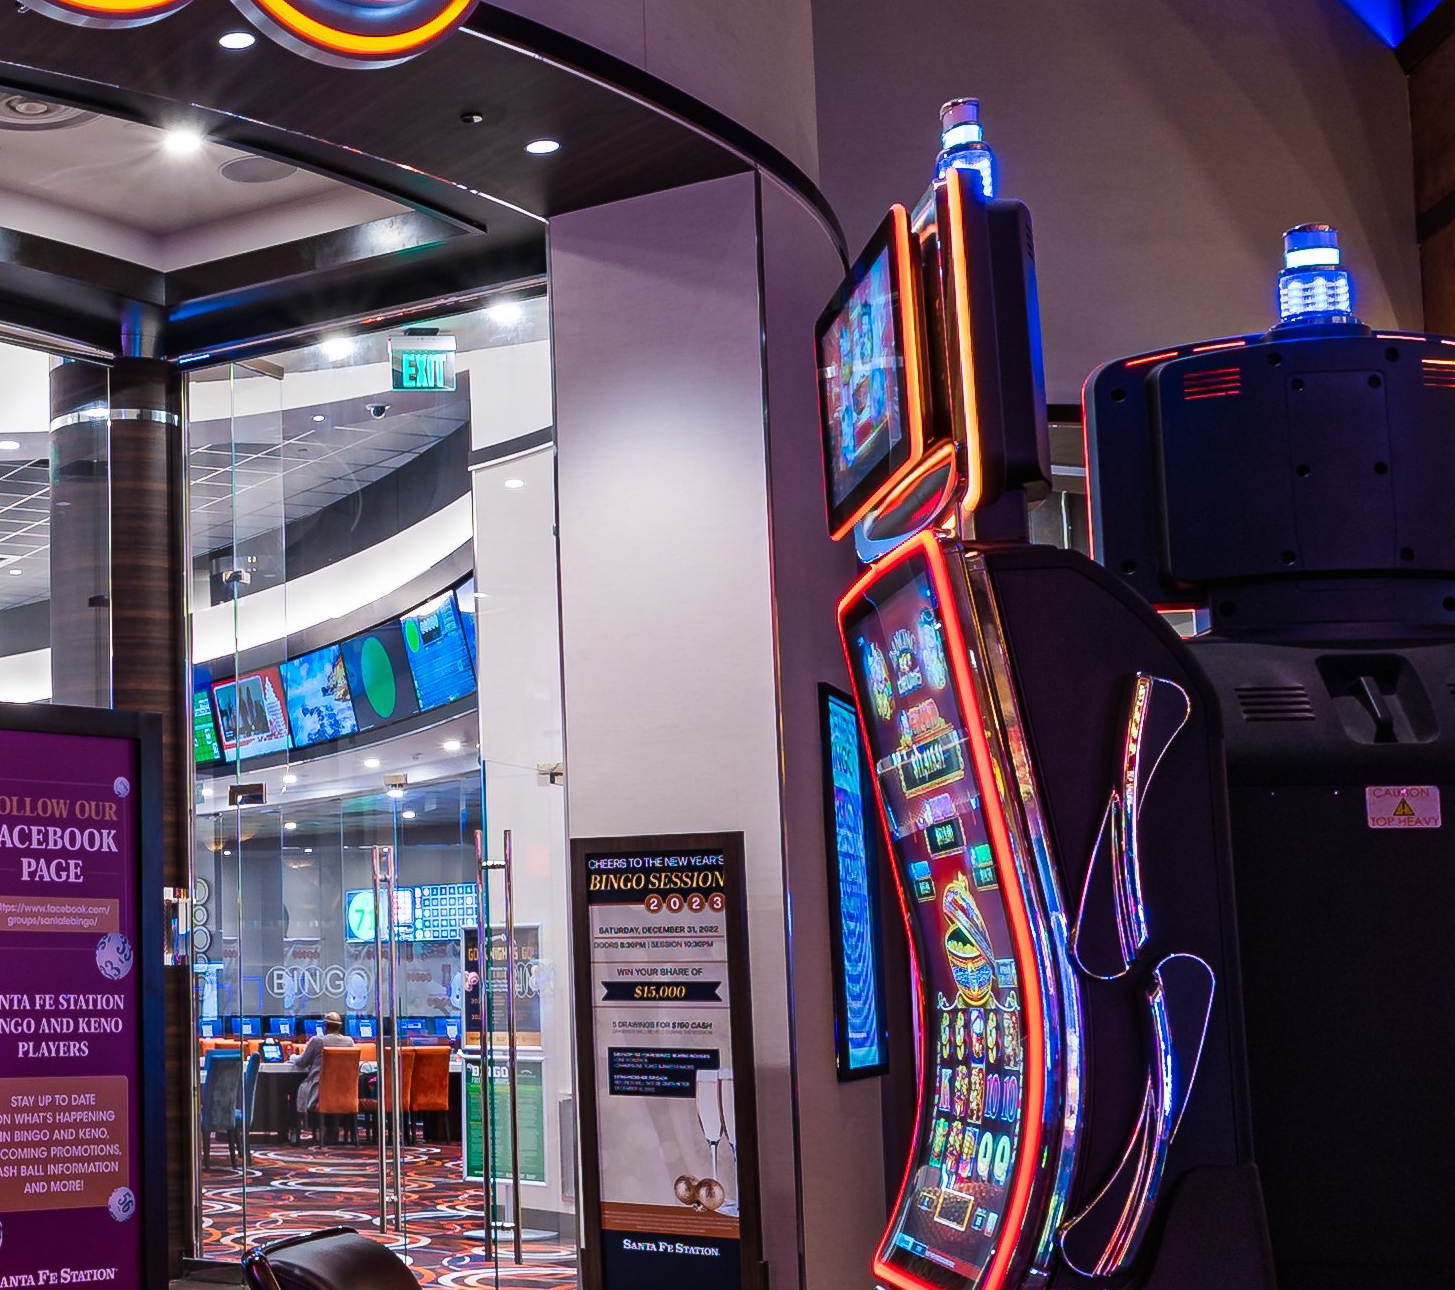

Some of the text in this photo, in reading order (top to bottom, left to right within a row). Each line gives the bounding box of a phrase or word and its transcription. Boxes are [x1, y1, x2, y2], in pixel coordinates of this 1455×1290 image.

[402, 354, 446, 388] EXIT
[75, 800, 118, 821] OUR
[1370, 817, 1439, 826] TOP HEAVY
[20, 858, 84, 882] PAGE
[588, 854, 724, 870] CHEERS TO THE NEW YEAR'S
[590, 871, 725, 891] BINGO SESSION
[7, 914, 99, 928] groups/santafebingo/
[617, 968, 703, 976] WIN YOUR SHARE OF
[634, 986, 686, 998] $15,000
[35, 994, 55, 1010] FE
[59, 993, 125, 1010] STATION
[39, 1018, 73, 1034] AND
[78, 1017, 123, 1033] KENO
[17, 1041, 89, 1058] PLAYERS
[10, 1093, 96, 1107] STAY UP TO DATE
[14, 1111, 53, 1125] WHAT'S
[56, 1110, 115, 1123] HAPPENING
[0, 1127, 110, 1143] IN BINGO AND KENO,
[50, 1144, 122, 1159] PROMOTIONS,
[20, 1164, 45, 1178] BALL
[47, 1161, 119, 1176] INFORMATION
[24, 1179, 84, 1194] AND MORE!
[623, 1239, 720, 1257] SANTA FE STATION
[38, 1269, 57, 1285] FE
[60, 1267, 115, 1284] STATION
